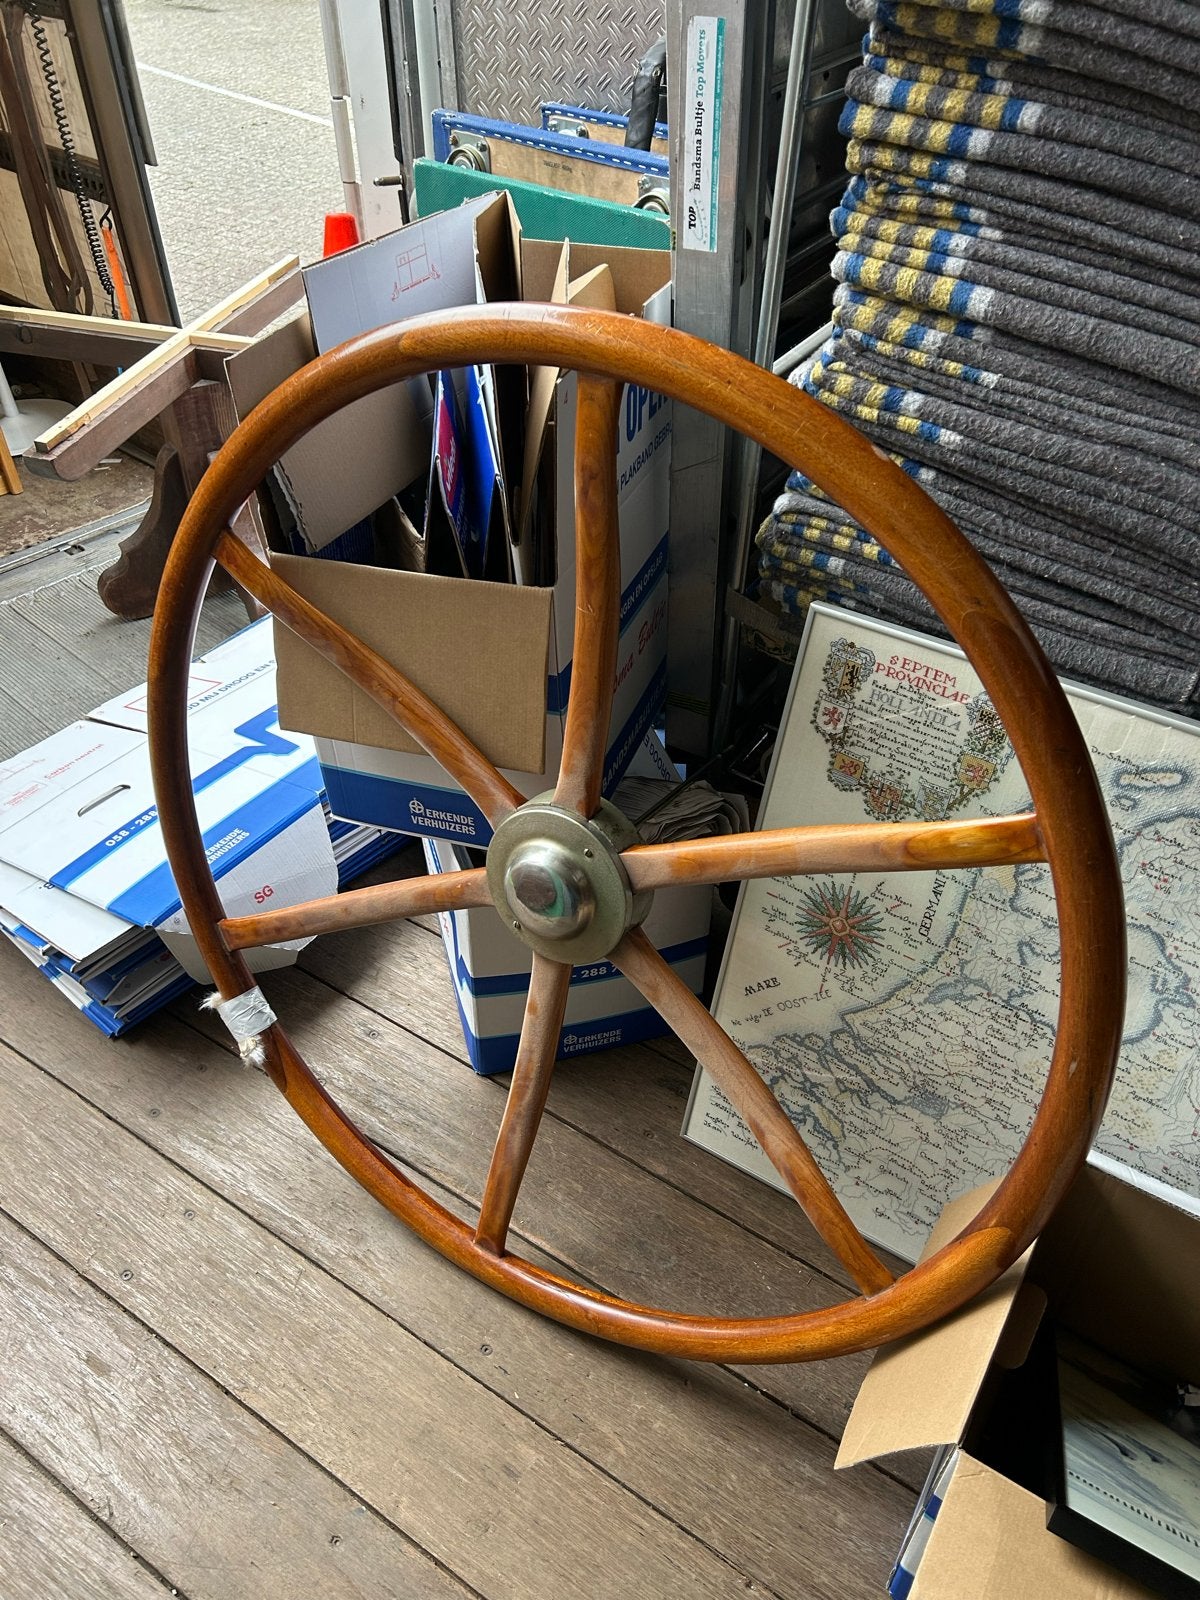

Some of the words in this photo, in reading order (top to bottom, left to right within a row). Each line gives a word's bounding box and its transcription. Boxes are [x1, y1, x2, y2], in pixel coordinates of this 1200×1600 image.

[696, 76, 706, 98] Top
[695, 100, 704, 136] Bultje
[692, 138, 702, 191] Bandsma
[688, 206, 697, 230] TOP
[105, 825, 130, 847] 058
[134, 808, 159, 829] 288
[410, 815, 476, 836] VERHUIZERS
[425, 808, 475, 826] ERKENDE
[206, 831, 251, 865] ERHUIZERS
[254, 884, 275, 904] SG
[918, 877, 948, 939] GERMANI
[580, 966, 608, 979] 288
[744, 976, 782, 997] MARE
[563, 1035, 623, 1053] VERHUIZERS
[576, 1028, 623, 1044] ERKENDE
